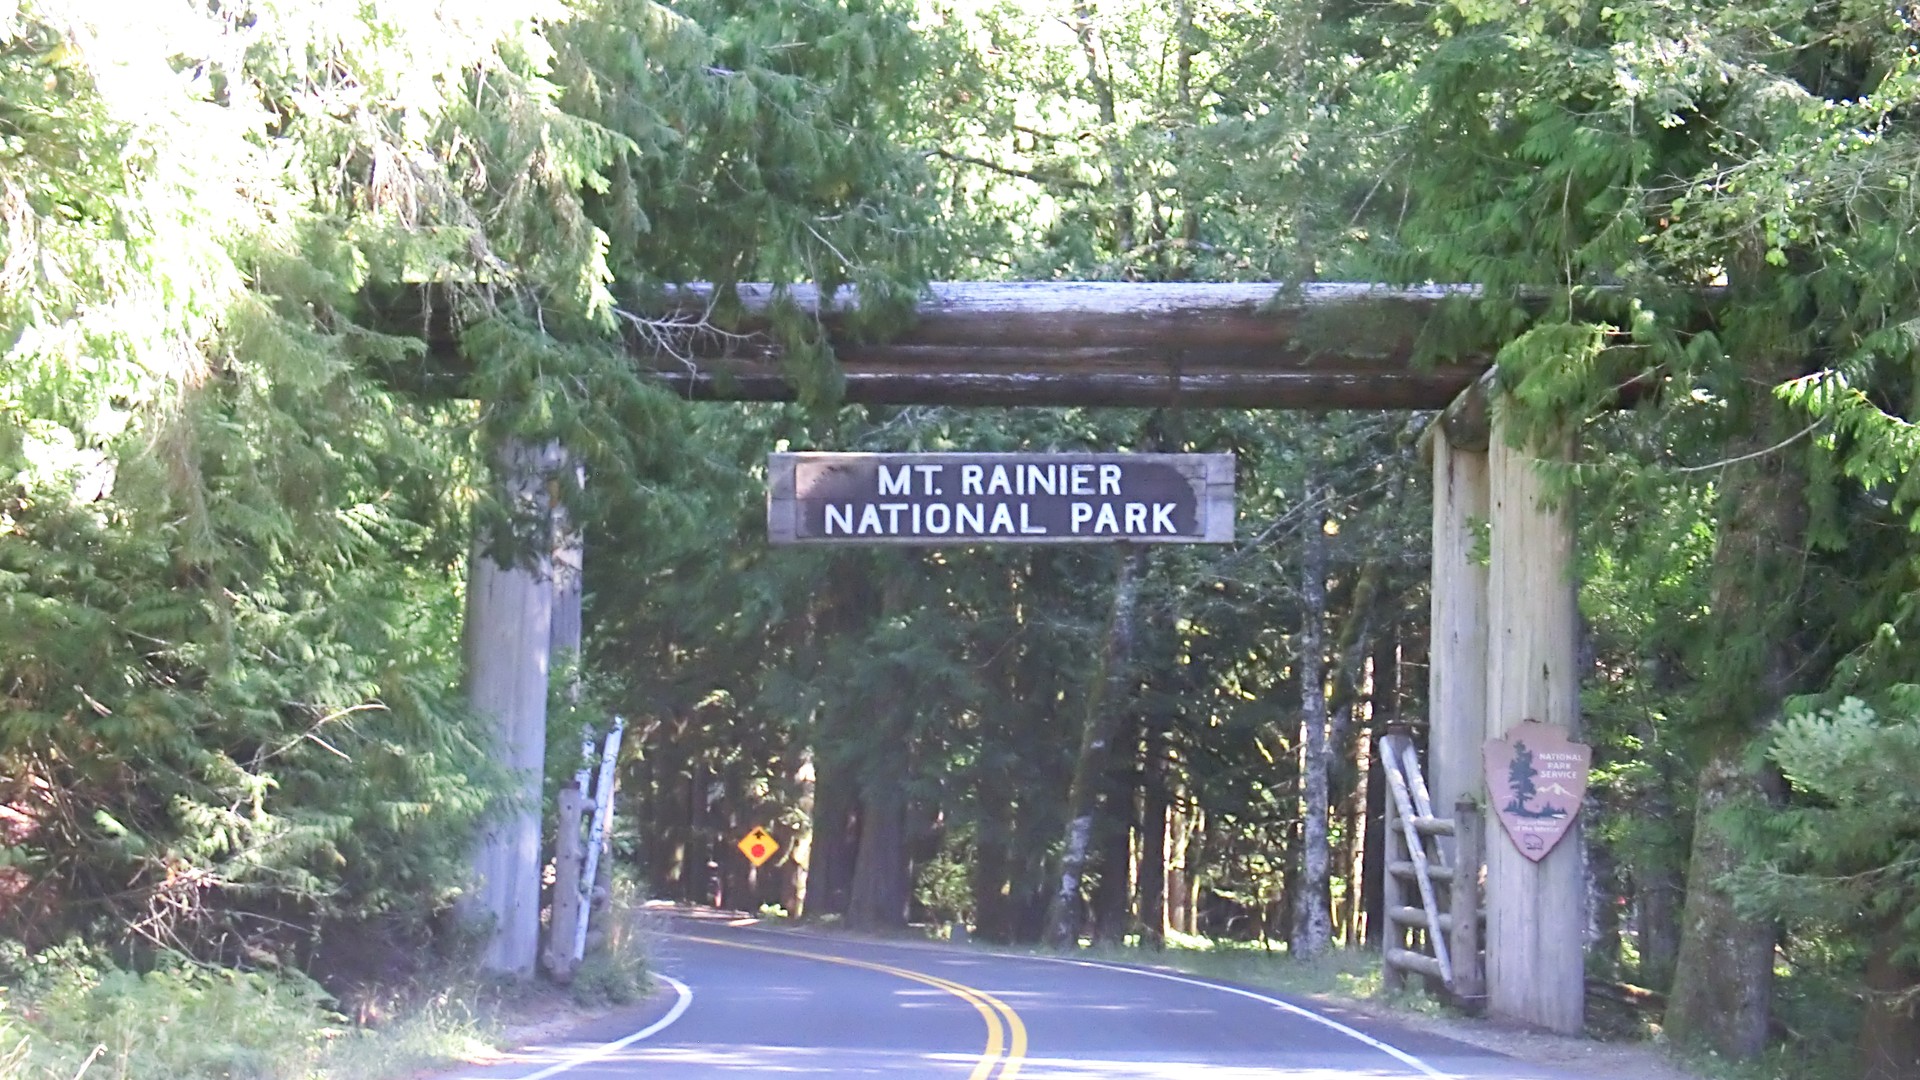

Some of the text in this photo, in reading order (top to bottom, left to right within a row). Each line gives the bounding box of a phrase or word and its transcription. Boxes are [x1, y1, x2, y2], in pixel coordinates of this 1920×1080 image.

[878, 464, 1122, 495] MT. RAINIER
[825, 503, 1177, 534] NATIONAL PARK
[1539, 753, 1583, 761] NATIONAL
[1540, 771, 1576, 779] SERVICE
